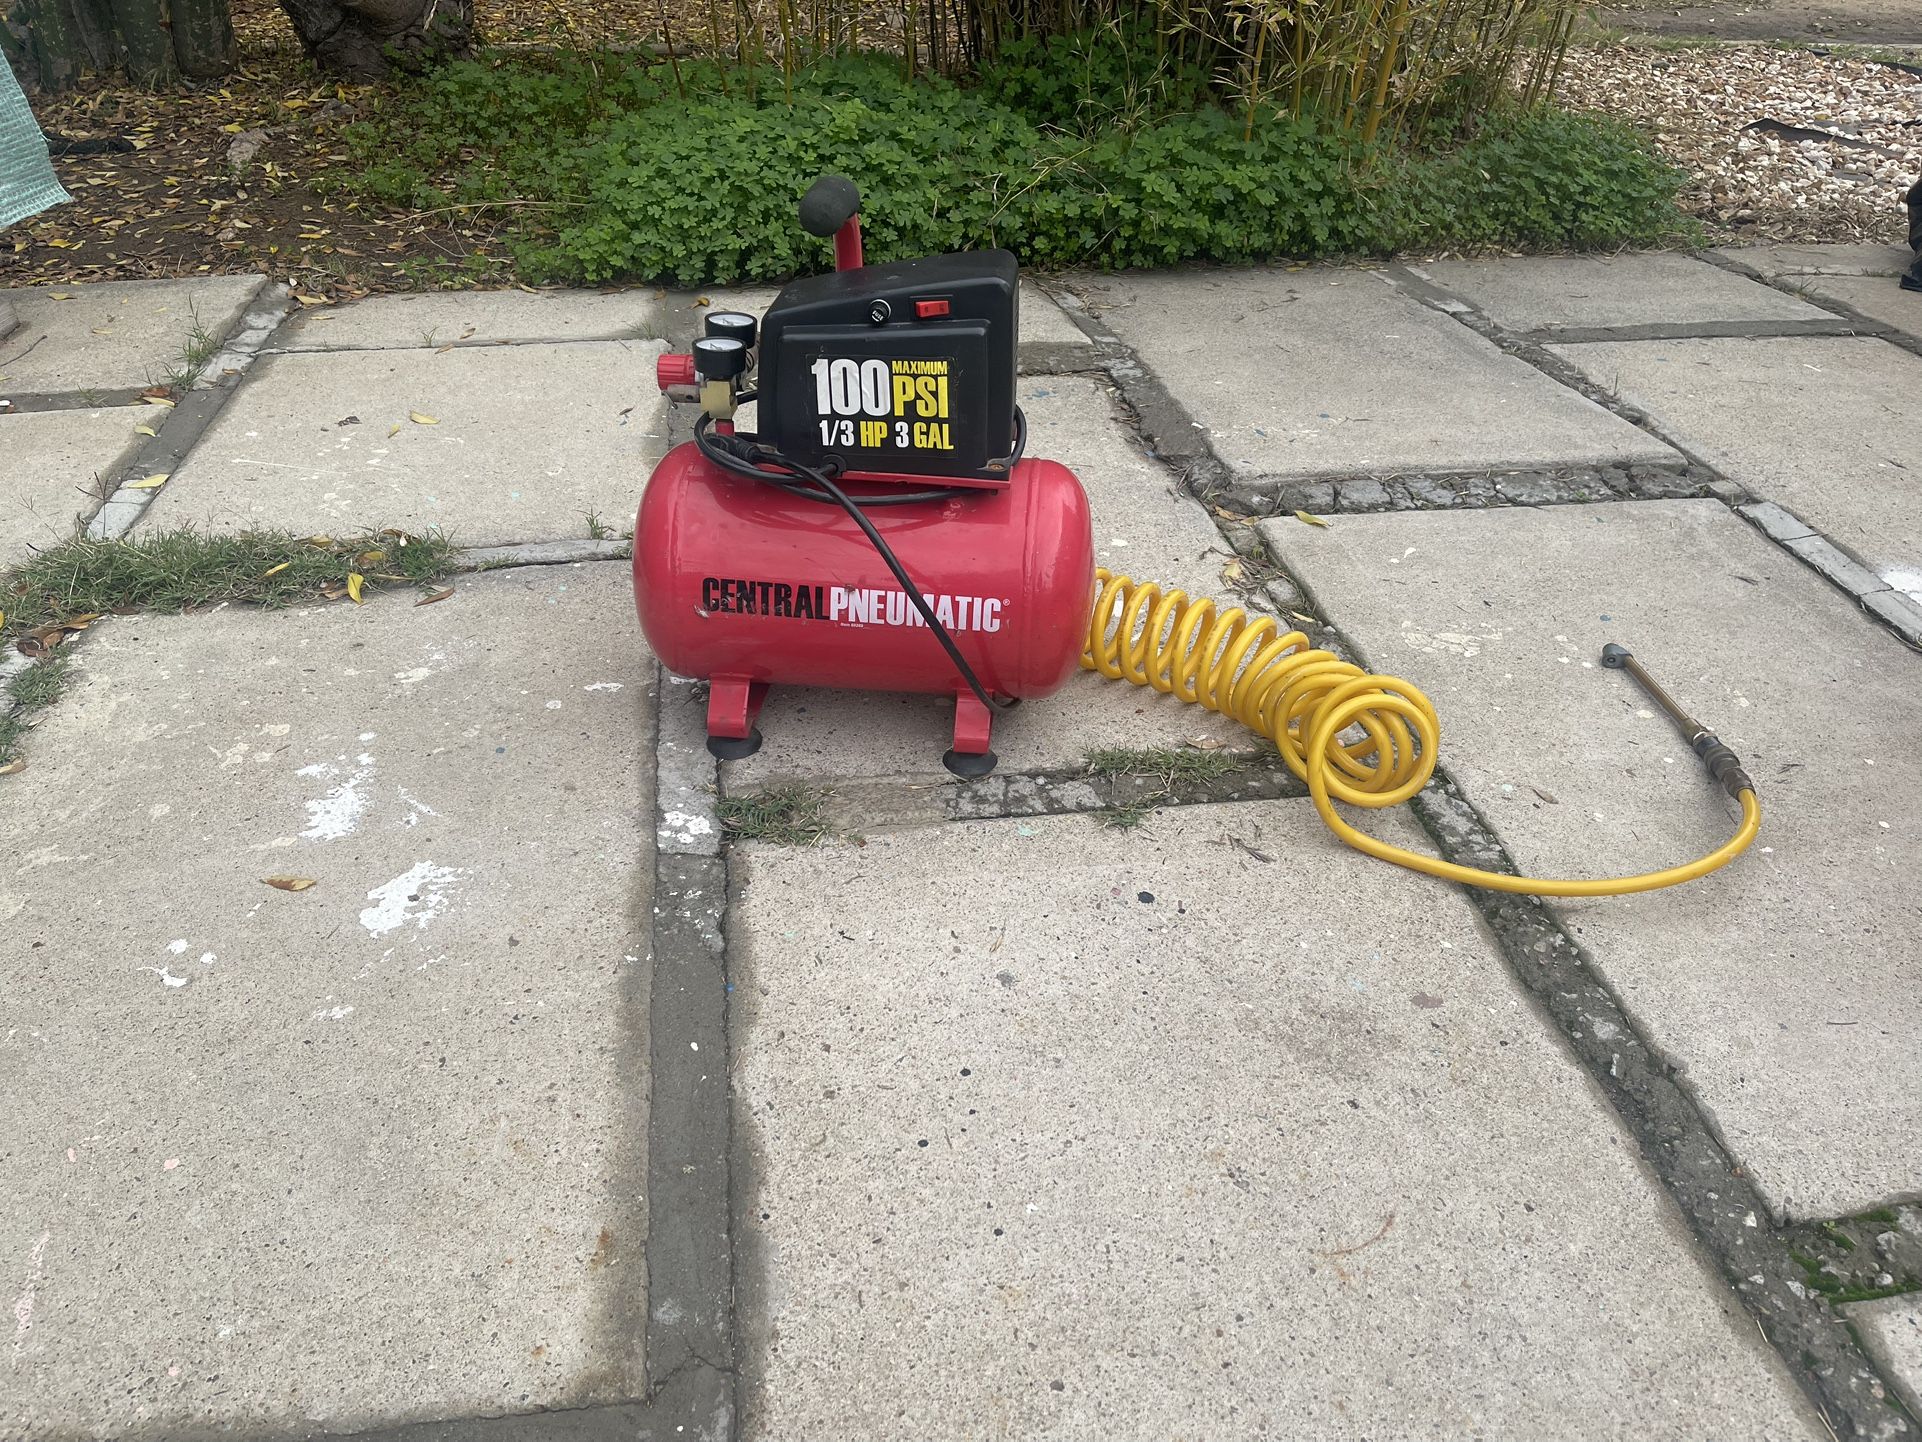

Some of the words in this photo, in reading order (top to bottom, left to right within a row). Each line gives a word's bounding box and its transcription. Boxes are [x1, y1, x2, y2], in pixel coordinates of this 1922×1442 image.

[811, 358, 891, 417] 100
[892, 360, 948, 375] MAXIMUM
[893, 375, 949, 418] PSI
[819, 419, 855, 447] 1/3
[860, 421, 888, 448] HP
[895, 421, 910, 448] 3
[913, 421, 955, 450] GAL
[702, 577, 830, 621] CENTRAL
